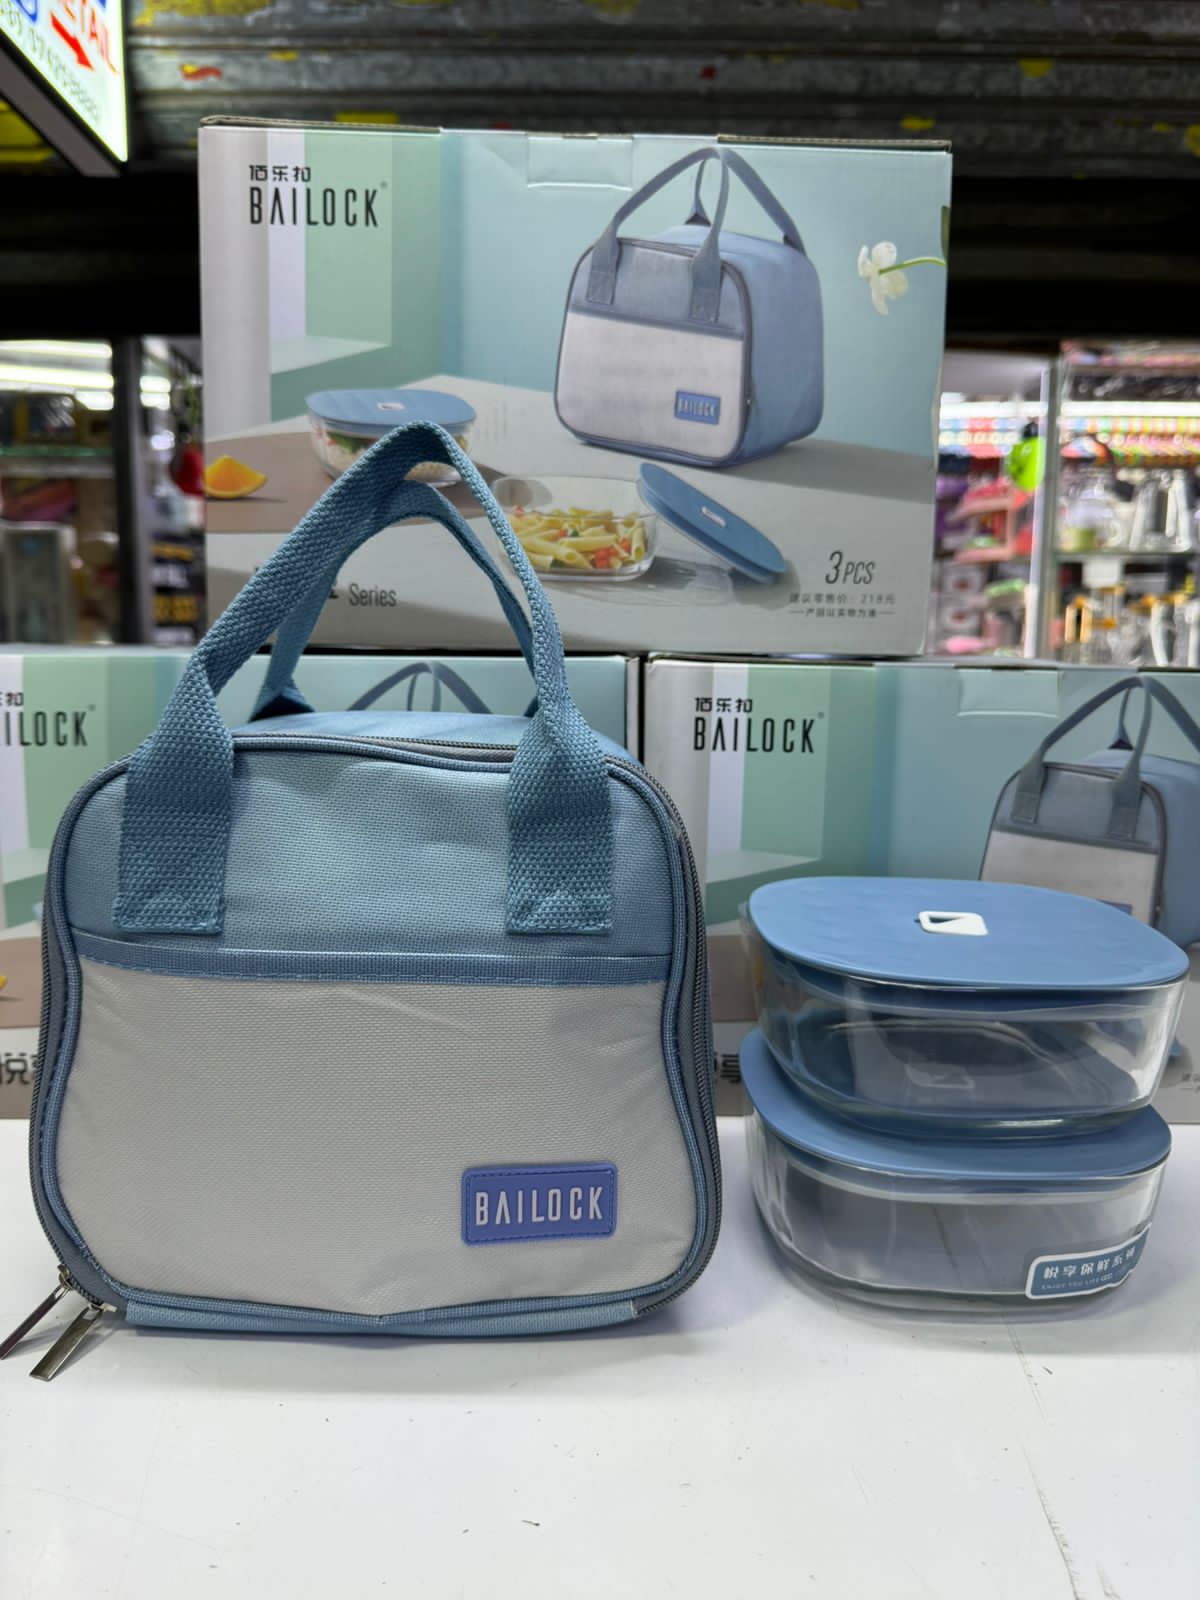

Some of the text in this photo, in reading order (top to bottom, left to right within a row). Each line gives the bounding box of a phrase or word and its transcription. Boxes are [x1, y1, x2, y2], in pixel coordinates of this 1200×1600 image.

[249, 164, 311, 182] 佰乐扣
[249, 186, 379, 227] BAILOCK
[349, 583, 397, 607] Series
[694, 697, 753, 713] 佰乐扣
[693, 716, 815, 753] BAILOCK
[475, 1186, 603, 1226] BAILOCK
